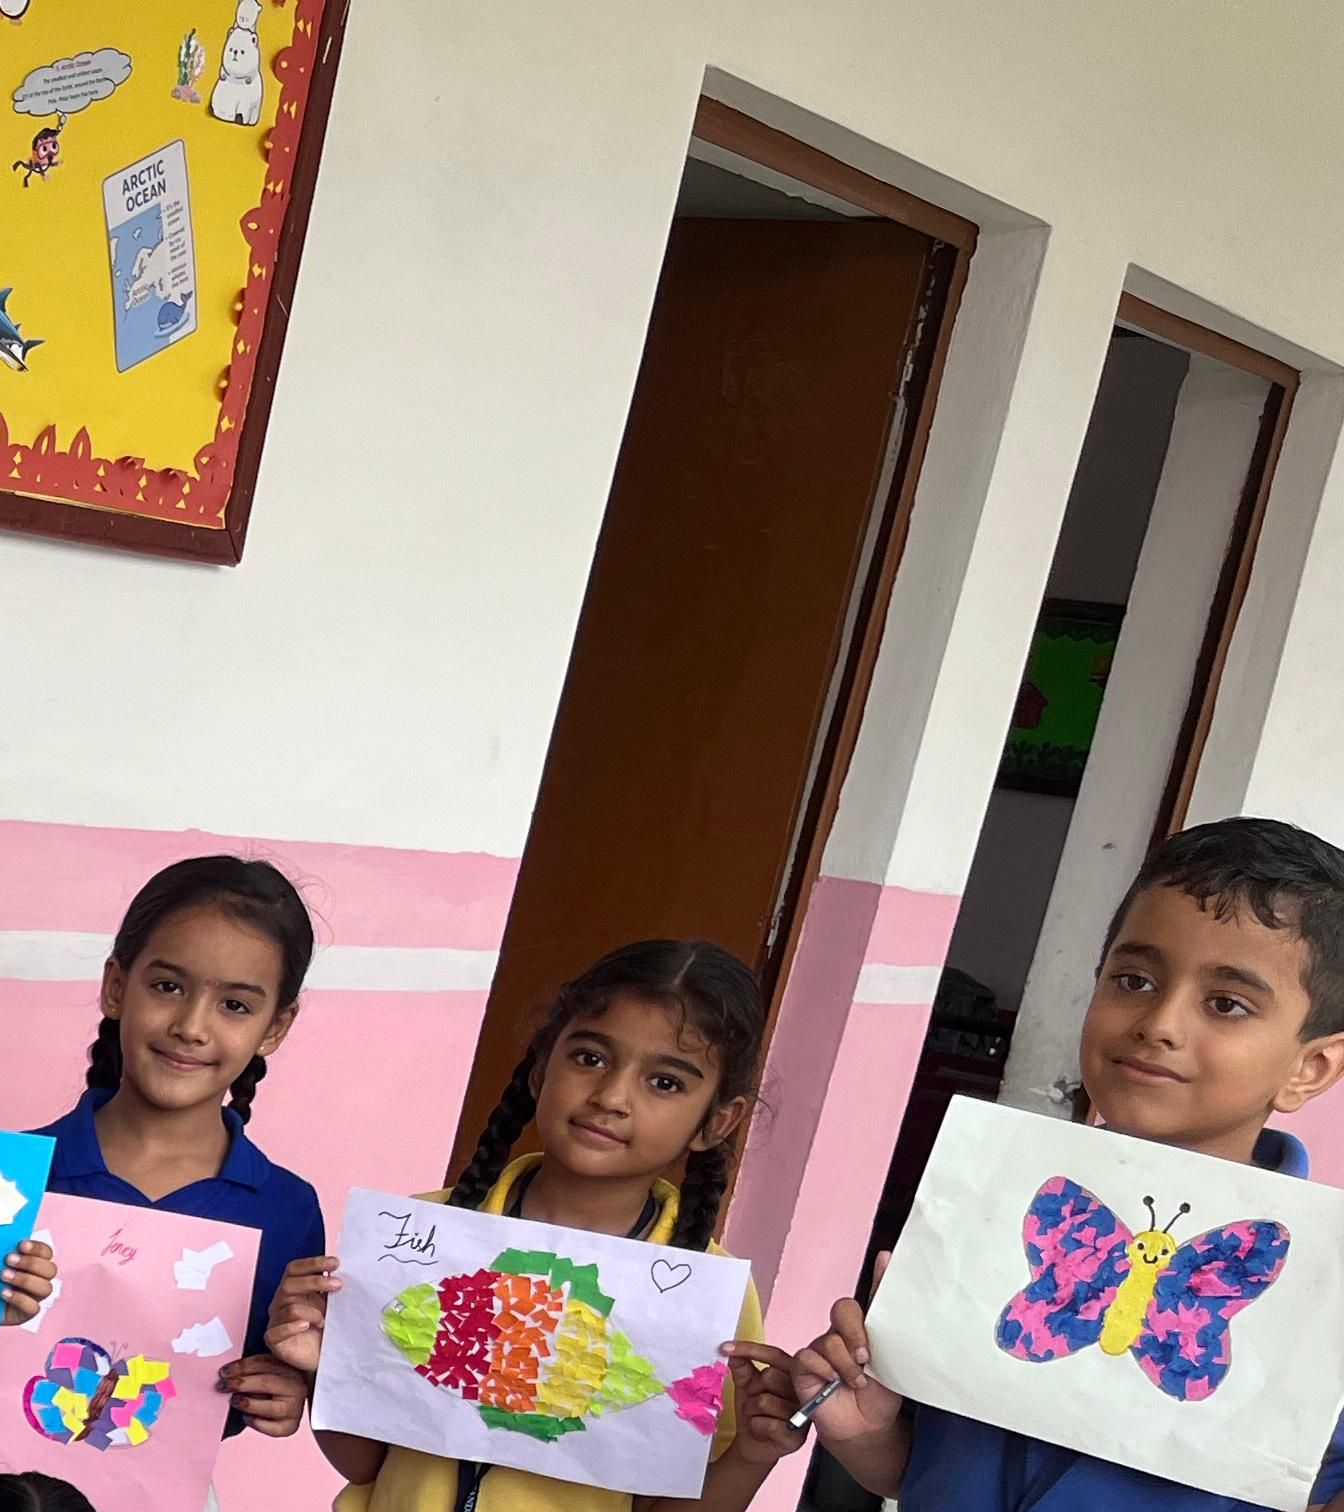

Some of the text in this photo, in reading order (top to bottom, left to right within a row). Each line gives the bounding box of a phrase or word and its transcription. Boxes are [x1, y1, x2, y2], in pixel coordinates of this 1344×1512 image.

[122, 160, 165, 195] ARCTIC
[125, 179, 167, 212] OCEAN
[378, 1211, 436, 1258] Fish
